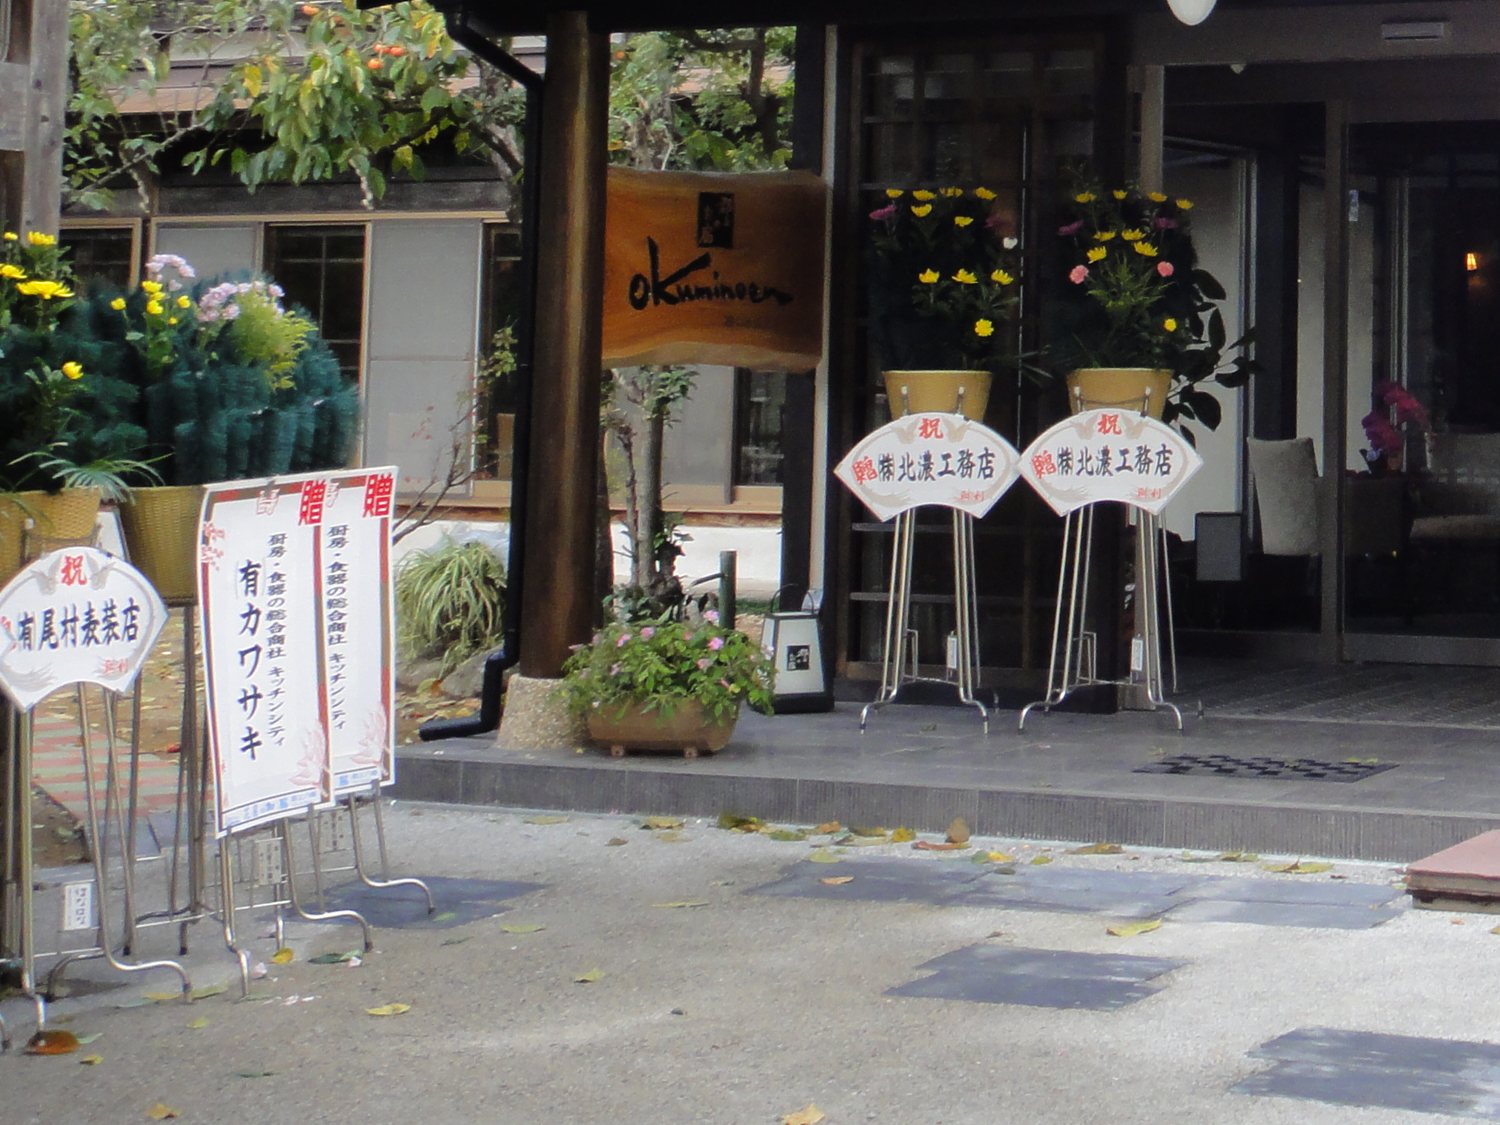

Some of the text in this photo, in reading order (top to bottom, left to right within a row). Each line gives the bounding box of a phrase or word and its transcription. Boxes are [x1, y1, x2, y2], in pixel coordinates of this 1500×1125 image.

[919, 418, 943, 439] 祝
[1098, 414, 1122, 435] 祝
[298, 479, 326, 526] 贈
[362, 472, 395, 518] 贈
[61, 555, 87, 586] 祝
